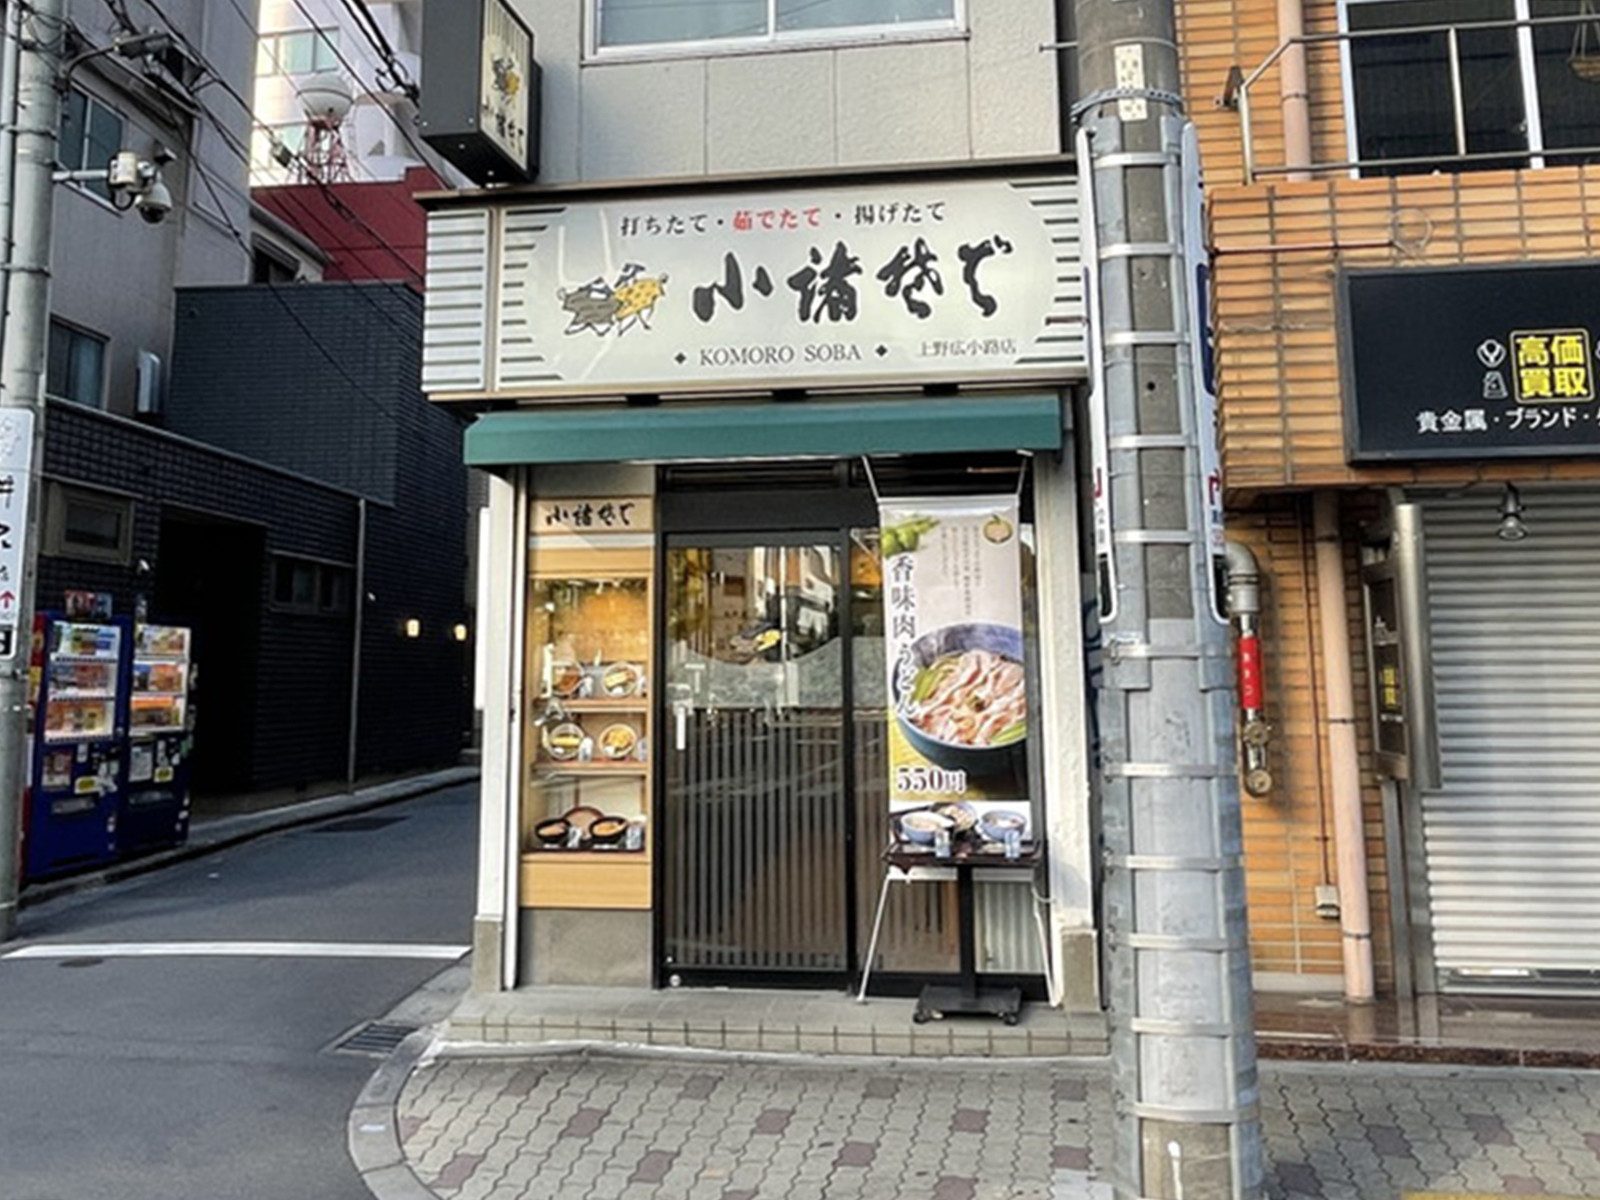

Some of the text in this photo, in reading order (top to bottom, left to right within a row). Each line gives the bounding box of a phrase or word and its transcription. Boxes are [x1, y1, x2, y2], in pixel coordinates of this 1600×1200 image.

[699, 343, 863, 366] KOMORO SOBA
[917, 338, 1018, 358] 上野広小路店
[1516, 334, 1585, 367] 高価
[1519, 366, 1589, 399] 買取
[1416, 405, 1600, 434] 貴金属・ブランド・
[897, 767, 967, 792] 550円
